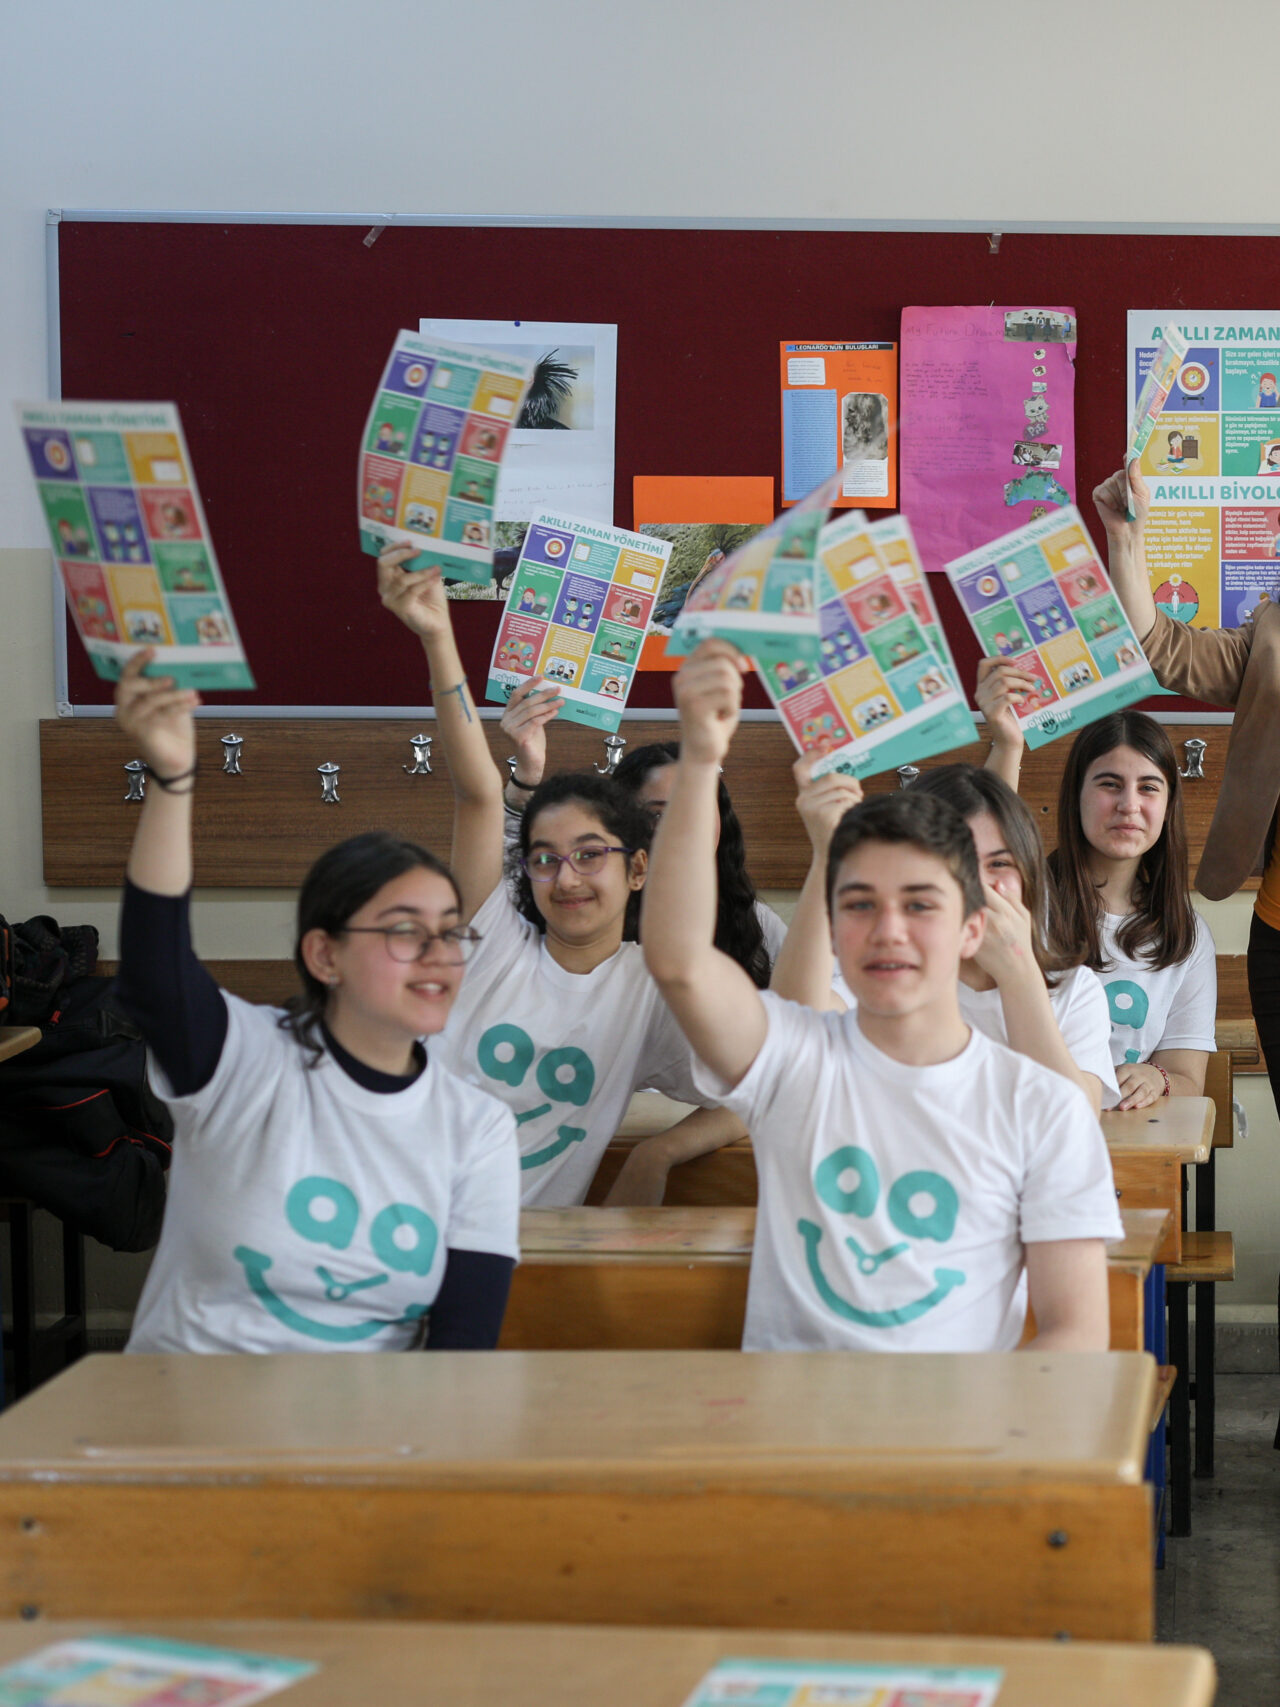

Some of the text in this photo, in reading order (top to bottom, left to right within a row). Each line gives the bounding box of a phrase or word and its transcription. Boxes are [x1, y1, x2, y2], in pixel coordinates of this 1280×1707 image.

[1214, 326, 1280, 341] ZAMAN
[1155, 485, 1213, 500] AKILLI
[539, 515, 665, 555] AKILLI ZAMAN YÖNETİMİ
